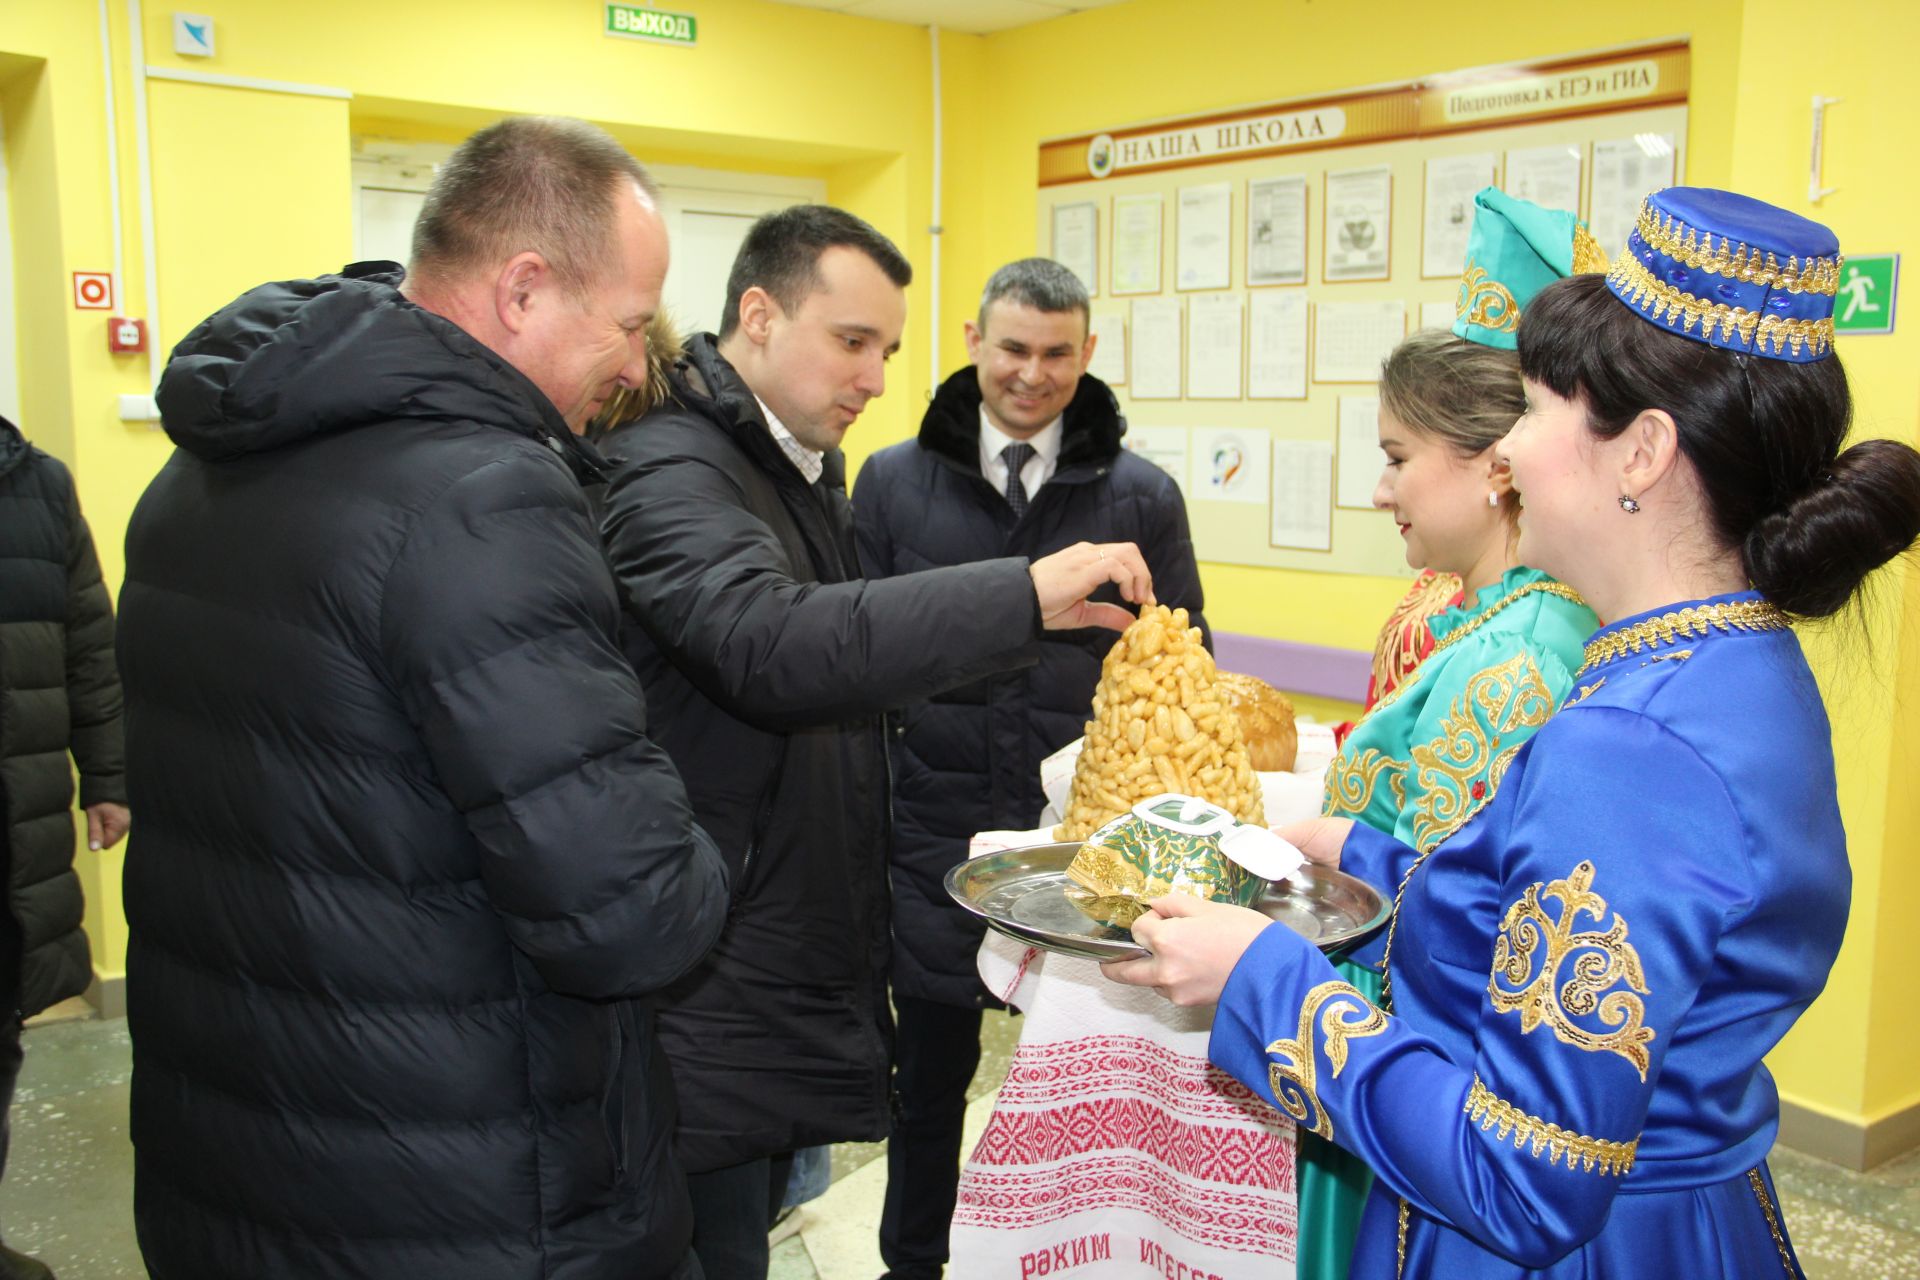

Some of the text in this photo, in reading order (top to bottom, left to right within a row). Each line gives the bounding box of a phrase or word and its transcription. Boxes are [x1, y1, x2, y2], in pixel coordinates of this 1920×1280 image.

[613, 8, 691, 40] ВЫХОД
[1450, 68, 1651, 115] Подготовка к ЕГЭ и ГИА
[1124, 115, 1325, 163] НАША ШКОЛА
